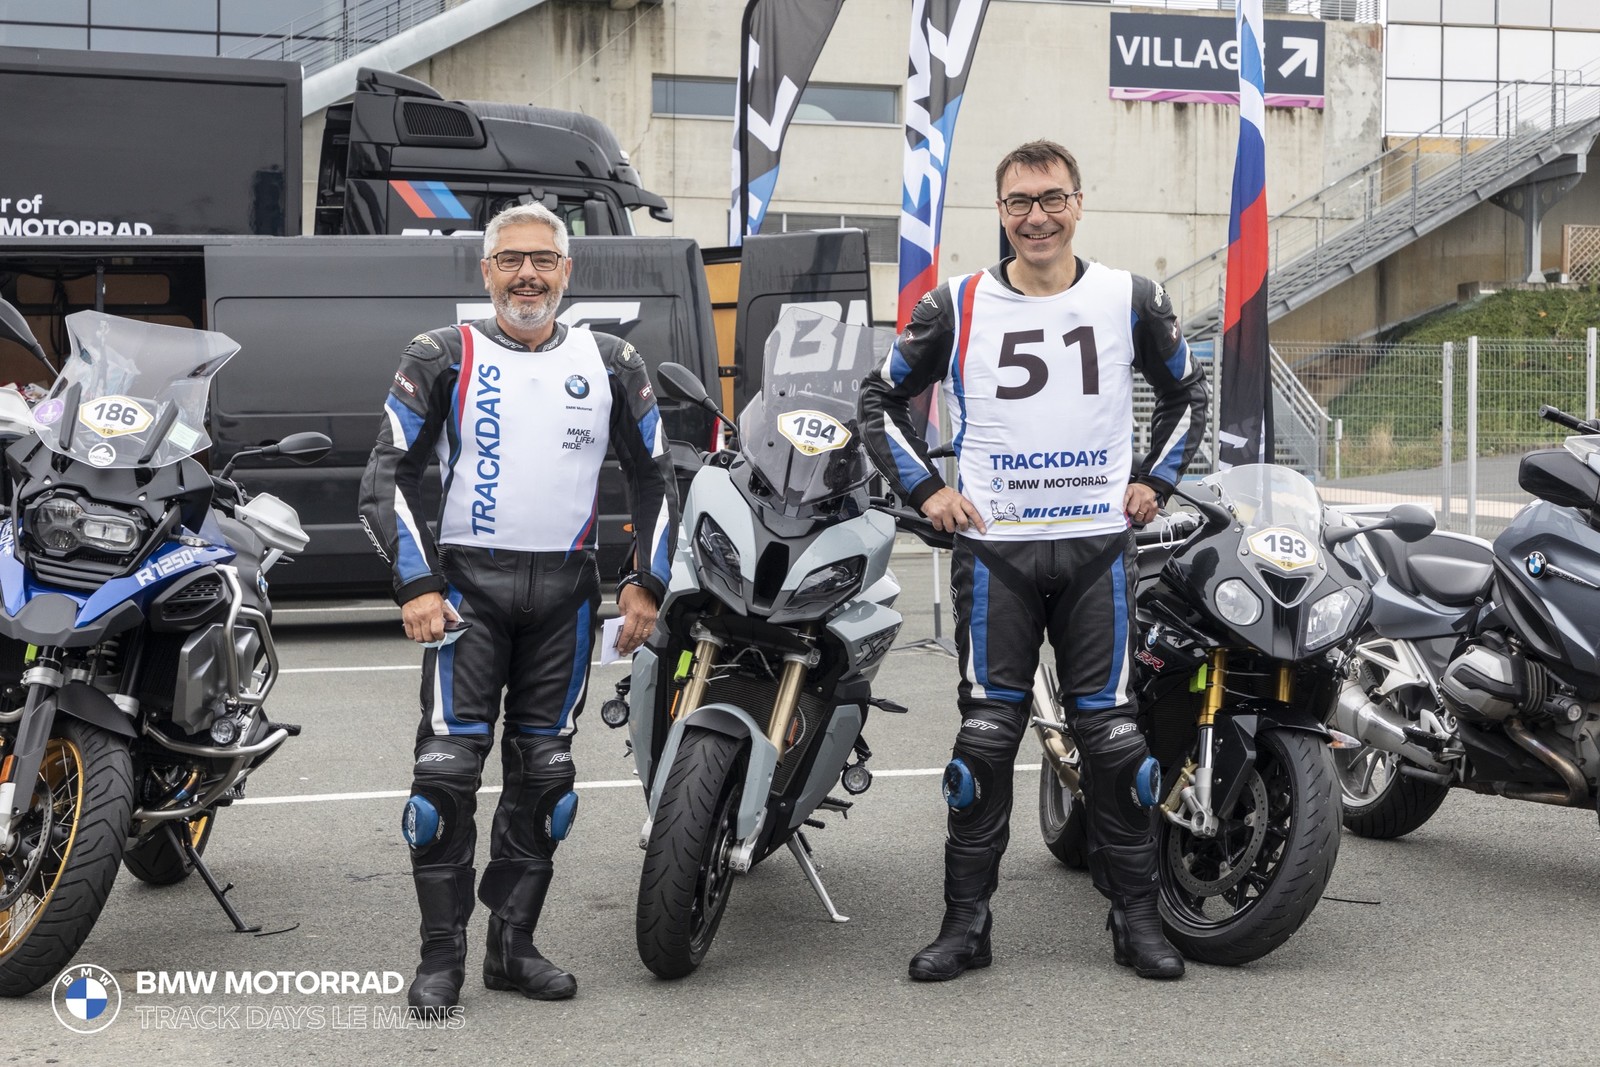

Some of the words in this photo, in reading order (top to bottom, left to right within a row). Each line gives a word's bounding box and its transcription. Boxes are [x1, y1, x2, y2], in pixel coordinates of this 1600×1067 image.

[1116, 35, 1266, 72] VILLAG
[16, 194, 42, 214] of
[0, 217, 153, 236] MOTORRAD
[995, 325, 1100, 400] 51
[94, 403, 138, 426] 186
[566, 428, 592, 438] MAKE
[793, 416, 837, 444] 194
[471, 363, 501, 536] TRACKDAYS
[562, 442, 582, 450] RIDE
[990, 450, 1108, 470] TRACKDAYS
[1008, 479, 1040, 490] BMW
[1043, 475, 1108, 489] MOTORRAD
[1022, 502, 1110, 519] MICHELIN
[1264, 534, 1307, 559] 193
